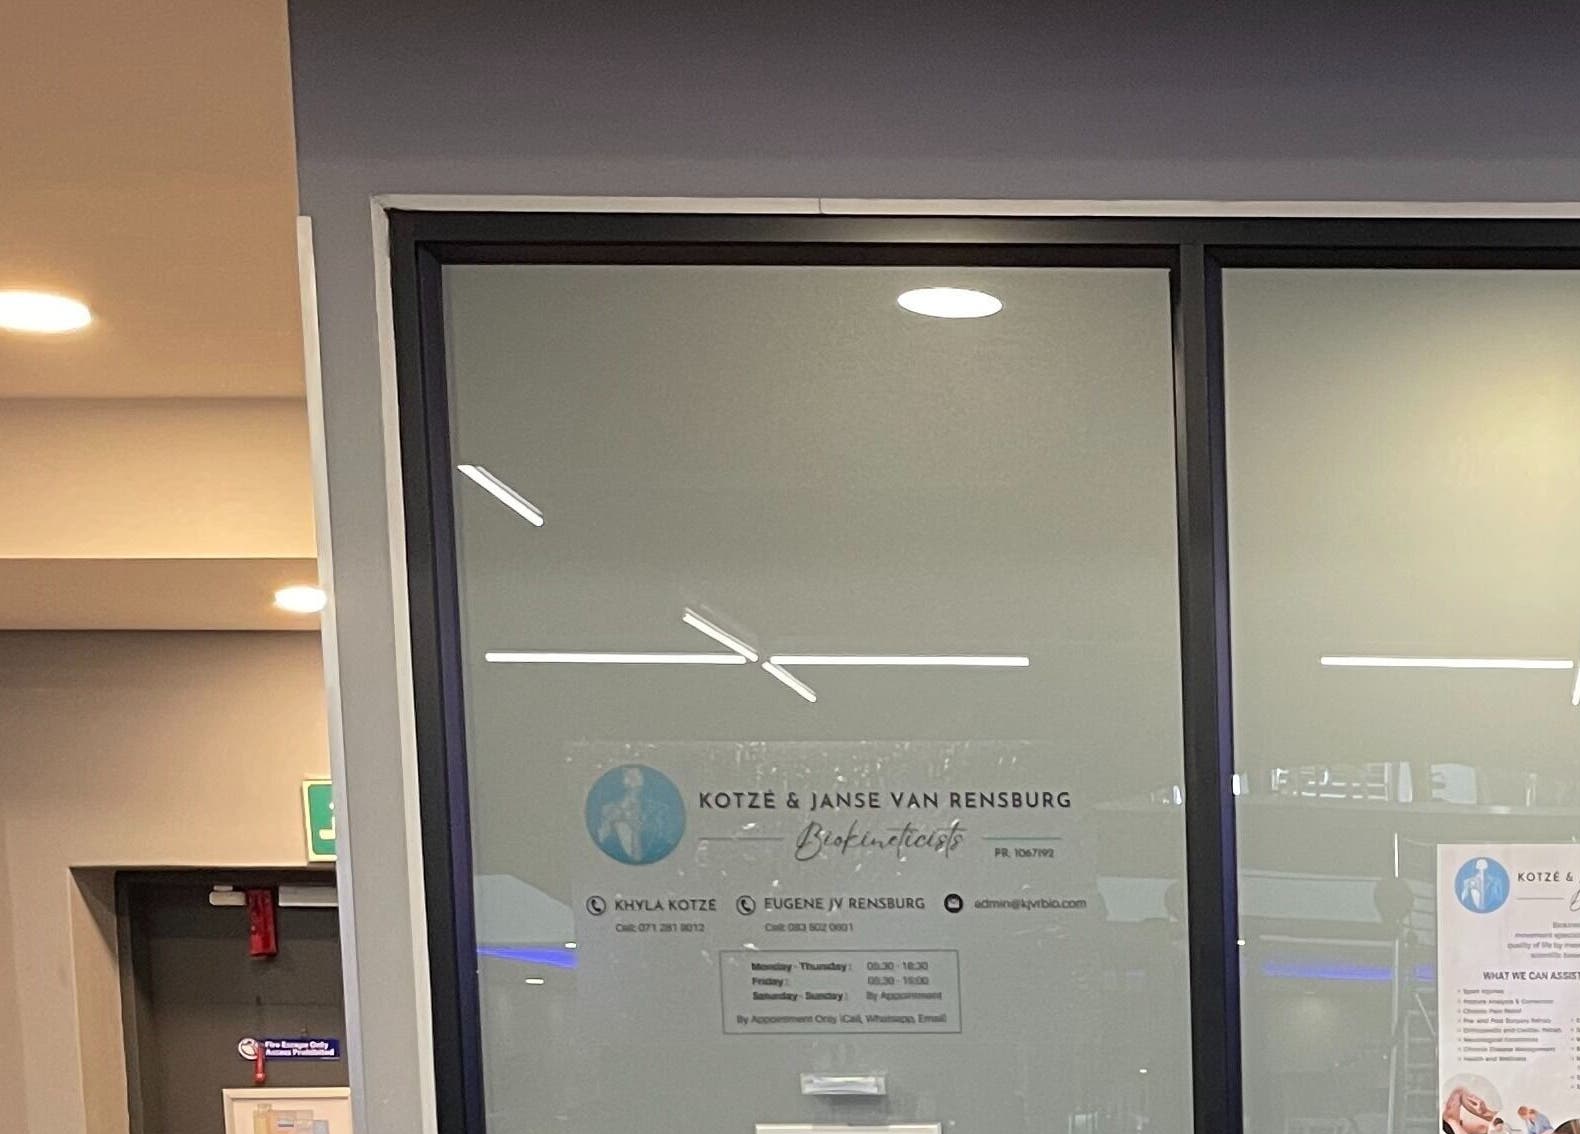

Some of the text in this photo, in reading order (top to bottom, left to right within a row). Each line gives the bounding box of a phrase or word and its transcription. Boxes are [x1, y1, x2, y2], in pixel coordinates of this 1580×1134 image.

[786, 792, 800, 809] &
[810, 792, 881, 809] JANSE
[890, 792, 939, 809] VAN
[950, 792, 1072, 809] RENSBURG
[795, 820, 967, 862] Biokineticists
[1517, 870, 1560, 882] KOTZÉ
[1566, 872, 1573, 882] &
[614, 898, 665, 911] KHYLA
[764, 897, 925, 910] EUGENE JV RENSBURG
[1483, 971, 1510, 981] WHAT
[1512, 971, 1526, 981] WE
[1529, 971, 1548, 981] CAN
